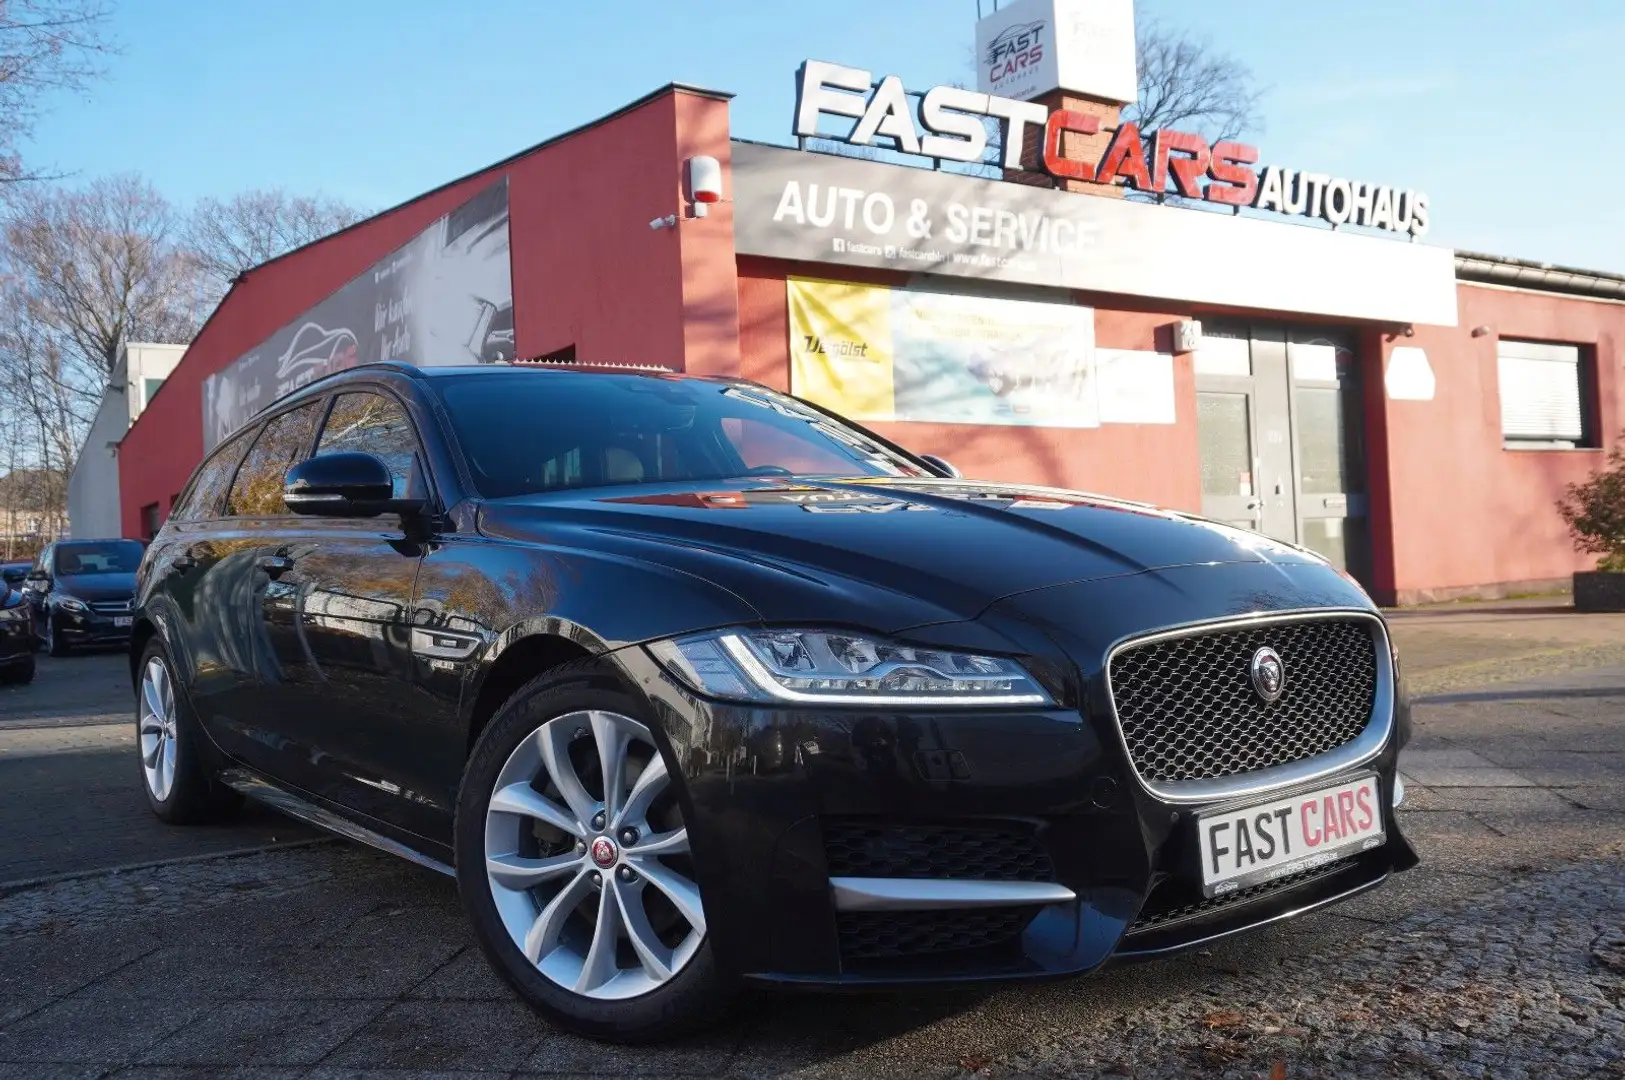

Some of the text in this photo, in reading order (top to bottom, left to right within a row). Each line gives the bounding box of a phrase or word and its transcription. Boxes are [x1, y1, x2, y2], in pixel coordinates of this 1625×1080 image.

[988, 25, 1044, 64] FAST
[989, 44, 1043, 83] CARS
[796, 59, 1430, 237] FAST CARS AUTOHAUS
[773, 180, 1100, 255] AUTO & SERVICE
[1209, 786, 1373, 874] FAST CARS
